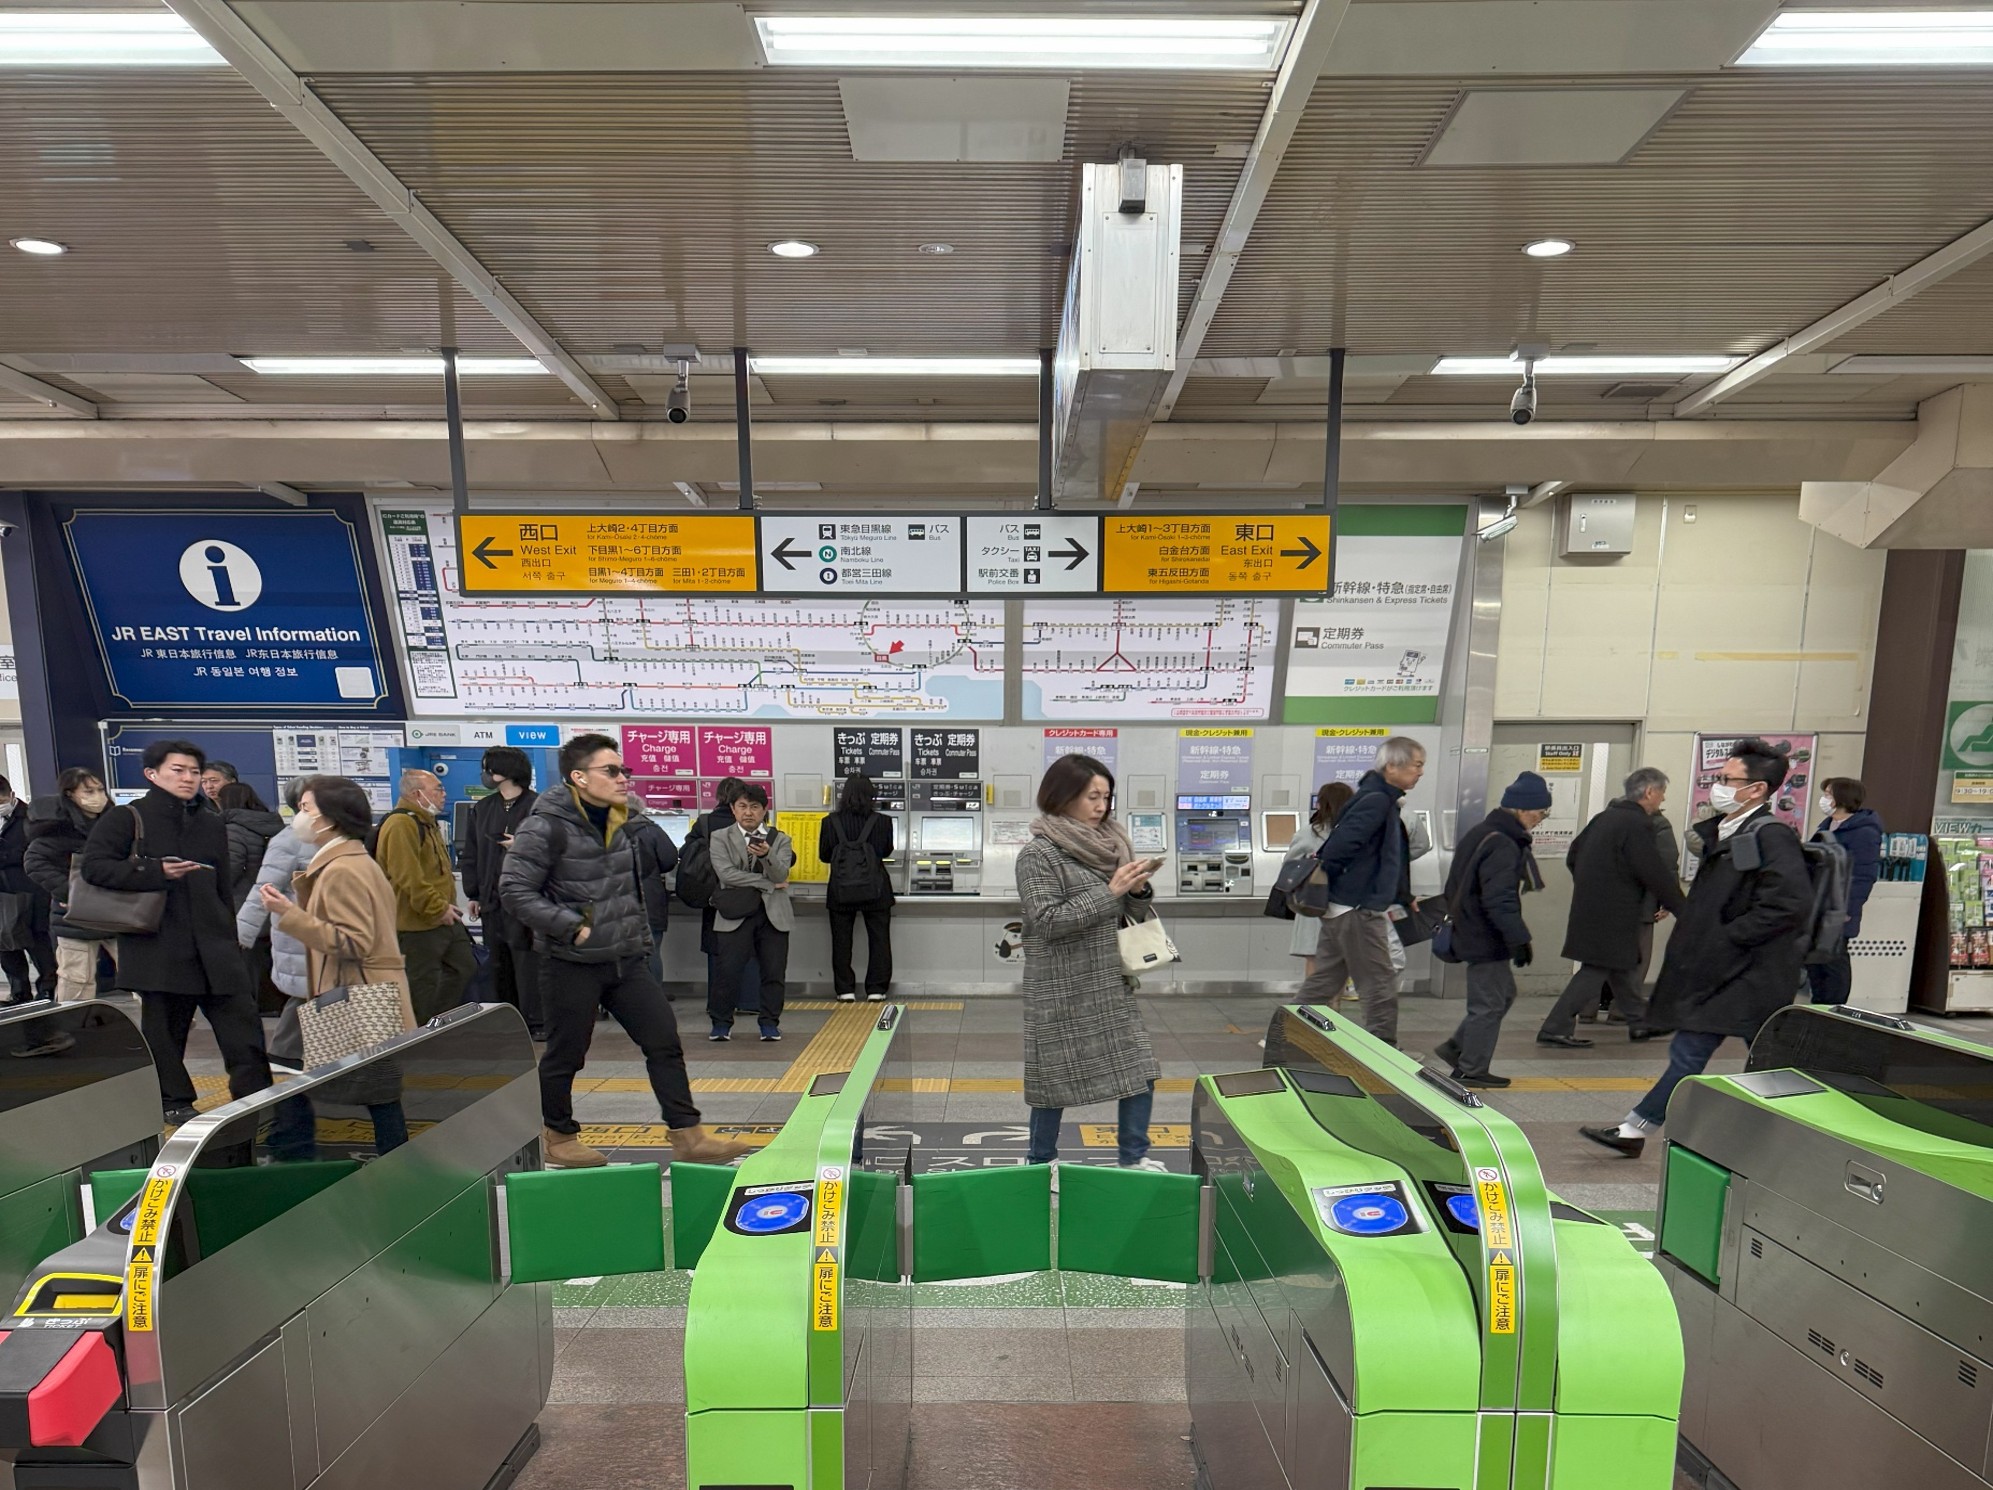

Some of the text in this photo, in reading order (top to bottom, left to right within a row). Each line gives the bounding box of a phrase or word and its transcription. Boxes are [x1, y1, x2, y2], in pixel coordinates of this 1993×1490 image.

[519, 524, 559, 541] 西口
[840, 524, 892, 534] 東急目黒線
[929, 524, 950, 534] バス
[1000, 524, 1019, 534] バス
[1235, 524, 1274, 541] 東口
[520, 545, 577, 555] West Exit
[840, 546, 872, 556] 南北線
[981, 547, 1019, 556] タクシー
[1159, 546, 1210, 555] 白金台方面
[1221, 546, 1273, 555] East Exit
[521, 558, 551, 568] 西出口
[1243, 559, 1273, 568] 东出口
[841, 569, 892, 579] 都営三田線
[978, 569, 1019, 578] 駅前交番
[1148, 568, 1209, 577] 東五反田方面
[1326, 597, 1374, 605] Shinkansen
[1384, 597, 1418, 605] Express
[111, 626, 361, 642] JR EAST Travel Information
[1322, 627, 1365, 640] 定期券
[1321, 642, 1384, 650] Commuter Pass
[140, 648, 153, 658] JR
[156, 648, 237, 660] 東日本旅行信息
[193, 666, 299, 677] JR 동일본 여행 정보
[474, 731, 493, 739] ATM
[627, 730, 691, 744] チャージ専用
[704, 731, 767, 745] チャージ専用
[1049, 729, 1113, 737] クレジットカード専用
[838, 732, 899, 746] きっぷ 定期券
[914, 733, 976, 747] きっぷ 定期券
[641, 744, 677, 754] Charge
[718, 745, 753, 755] Charge
[840, 747, 900, 756] Tickets Commuter Pass
[917, 748, 977, 757] Tickets Commuter Pass
[1190, 745, 1242, 755] 新幹線・特急
[920, 768, 937, 776] 승차권
[1199, 770, 1229, 779] 定期券
[648, 784, 691, 792] チャージ専用
[138, 1179, 169, 1243] かけこみ禁止
[819, 1181, 838, 1244] かけこみ禁止
[1484, 1182, 1508, 1246] かけこみ禁止
[132, 1265, 149, 1328] 扉にご注意
[818, 1266, 834, 1328] 扉にご注意
[1494, 1268, 1511, 1331] 扉にご注意
[44, 1317, 92, 1325] きっぷ
